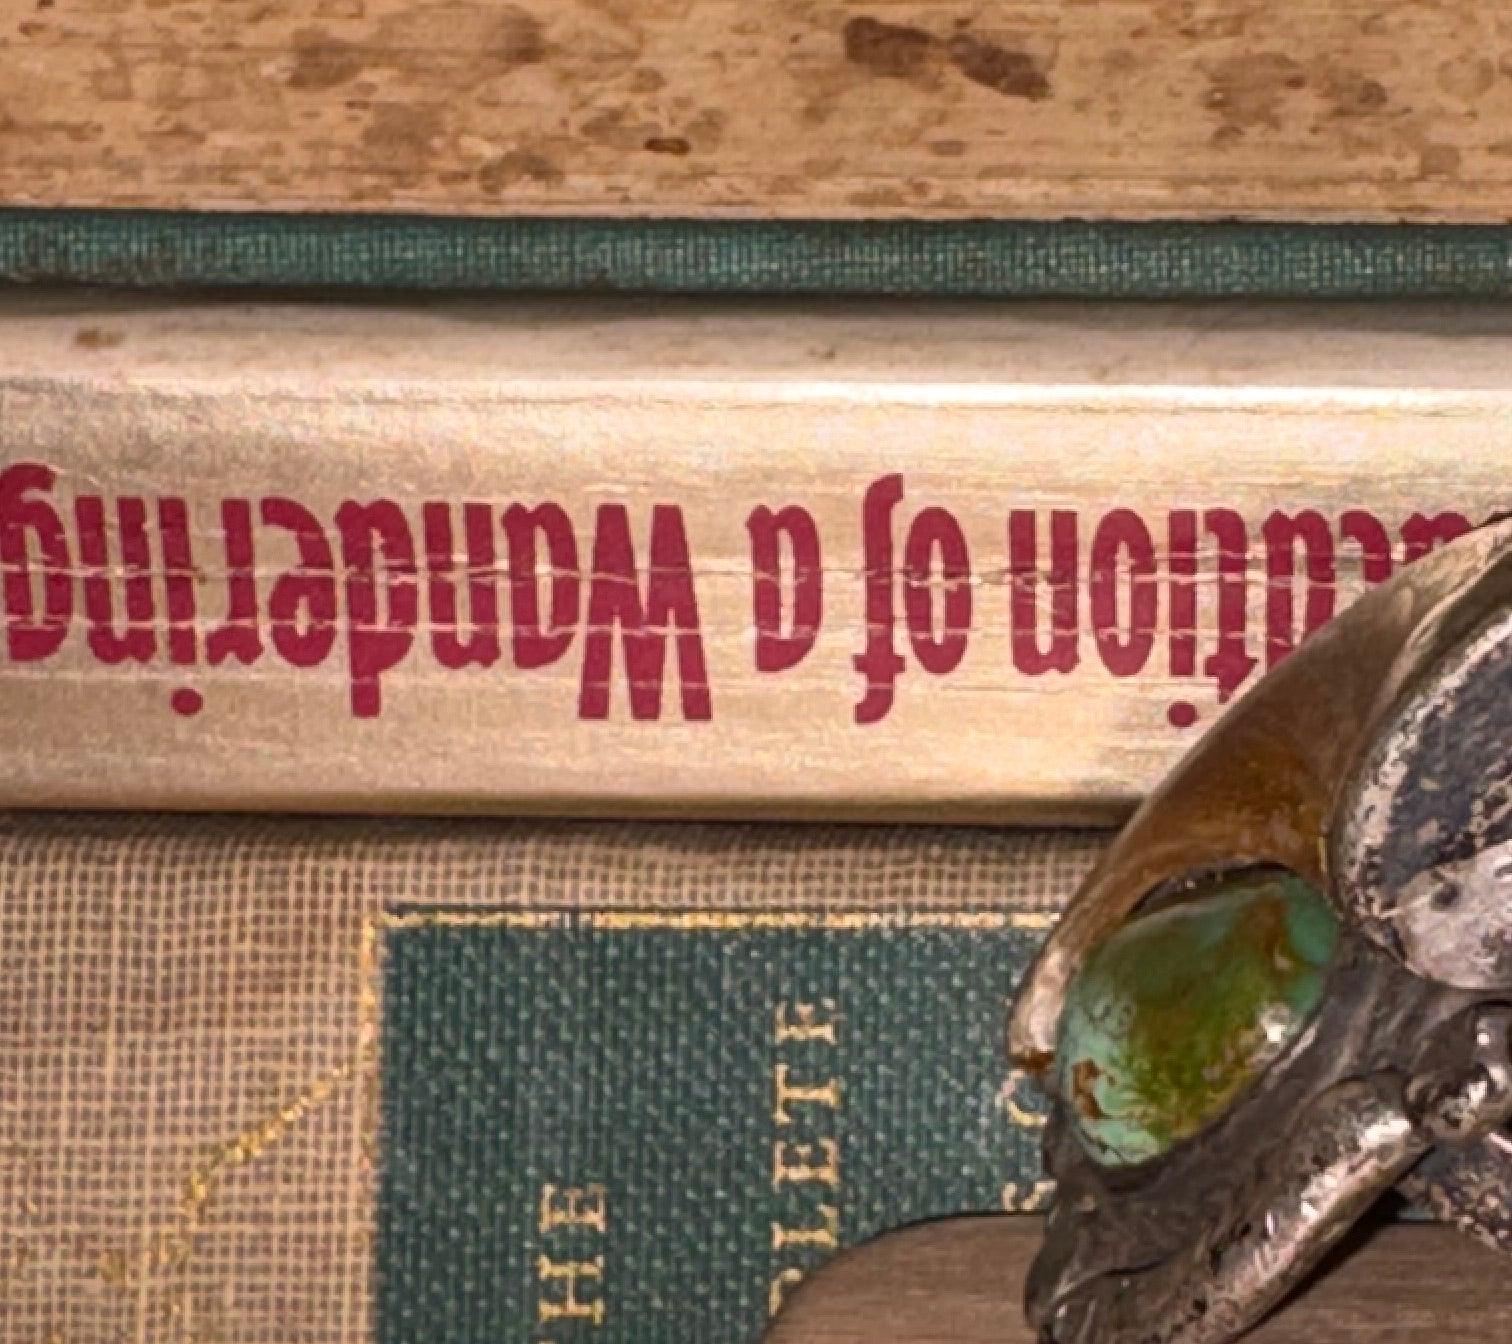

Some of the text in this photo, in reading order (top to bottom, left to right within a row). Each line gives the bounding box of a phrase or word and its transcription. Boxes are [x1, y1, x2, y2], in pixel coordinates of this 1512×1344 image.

[0, 462, 713, 721] Wandering
[745, 504, 823, 672] a
[853, 472, 973, 725] of
